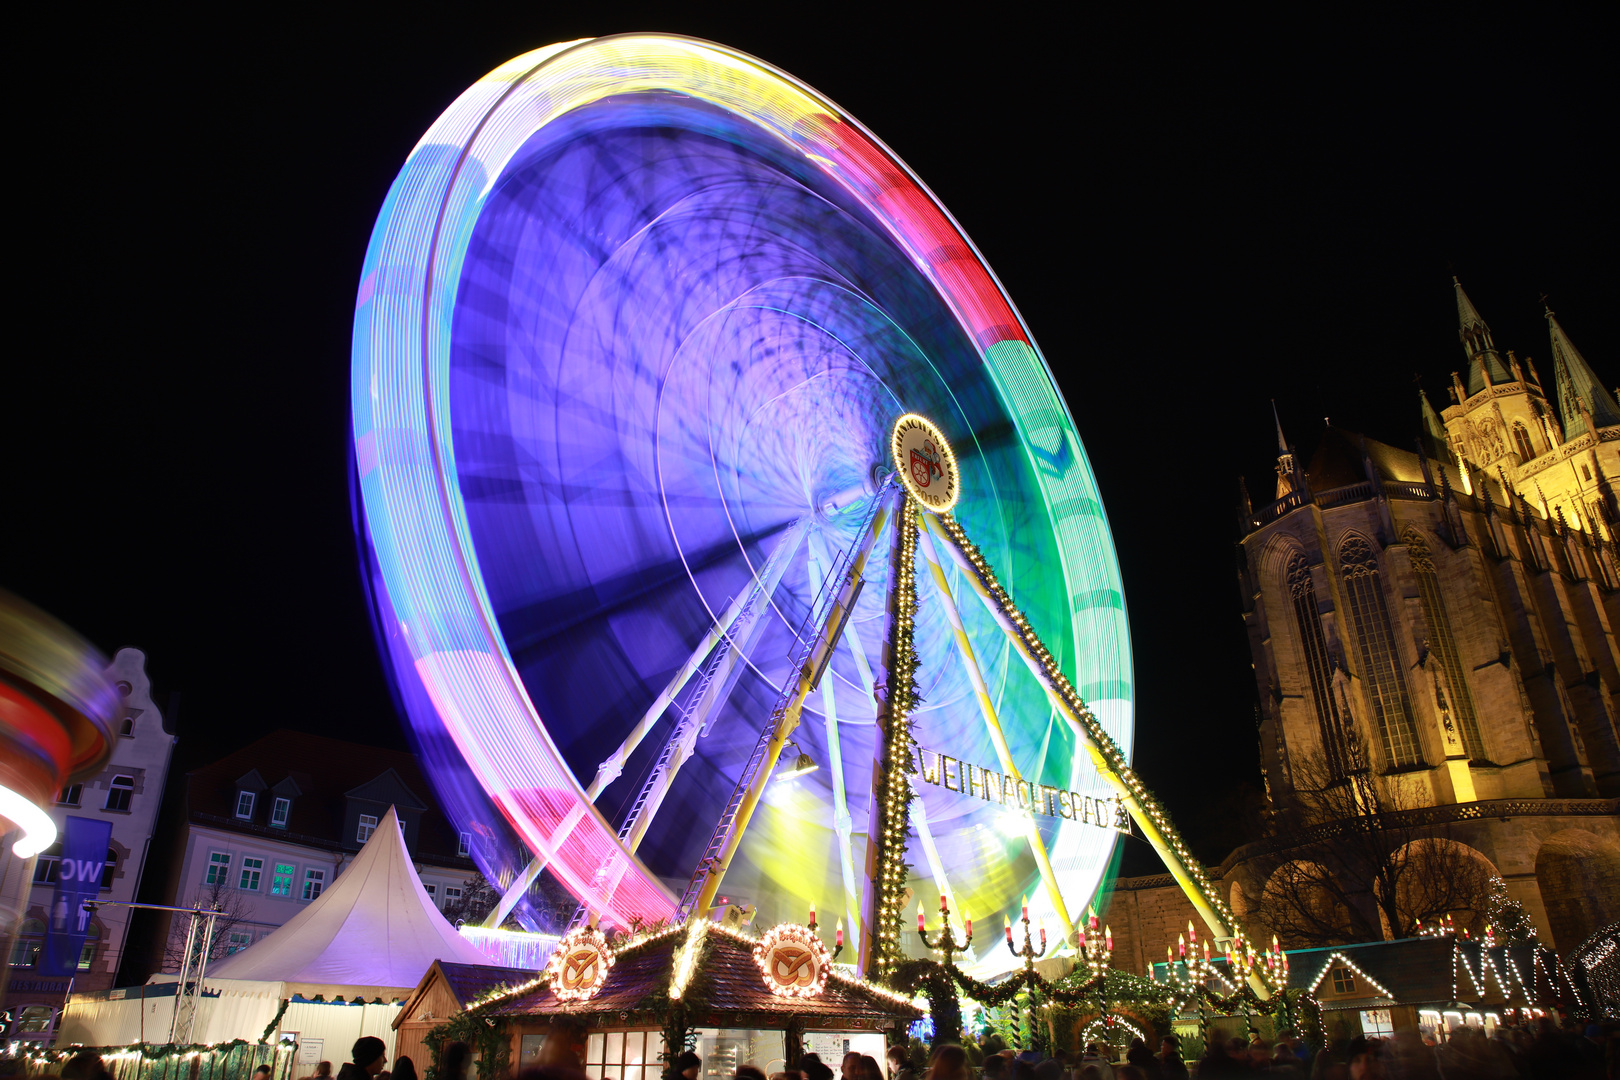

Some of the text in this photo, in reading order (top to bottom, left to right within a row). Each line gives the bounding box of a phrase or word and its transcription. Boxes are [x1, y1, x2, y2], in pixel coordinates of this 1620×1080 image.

[914, 485, 941, 507] 2018
[918, 747, 1108, 829] WEIHNACHTSRAD
[9, 980, 72, 992] RESTAURAN
